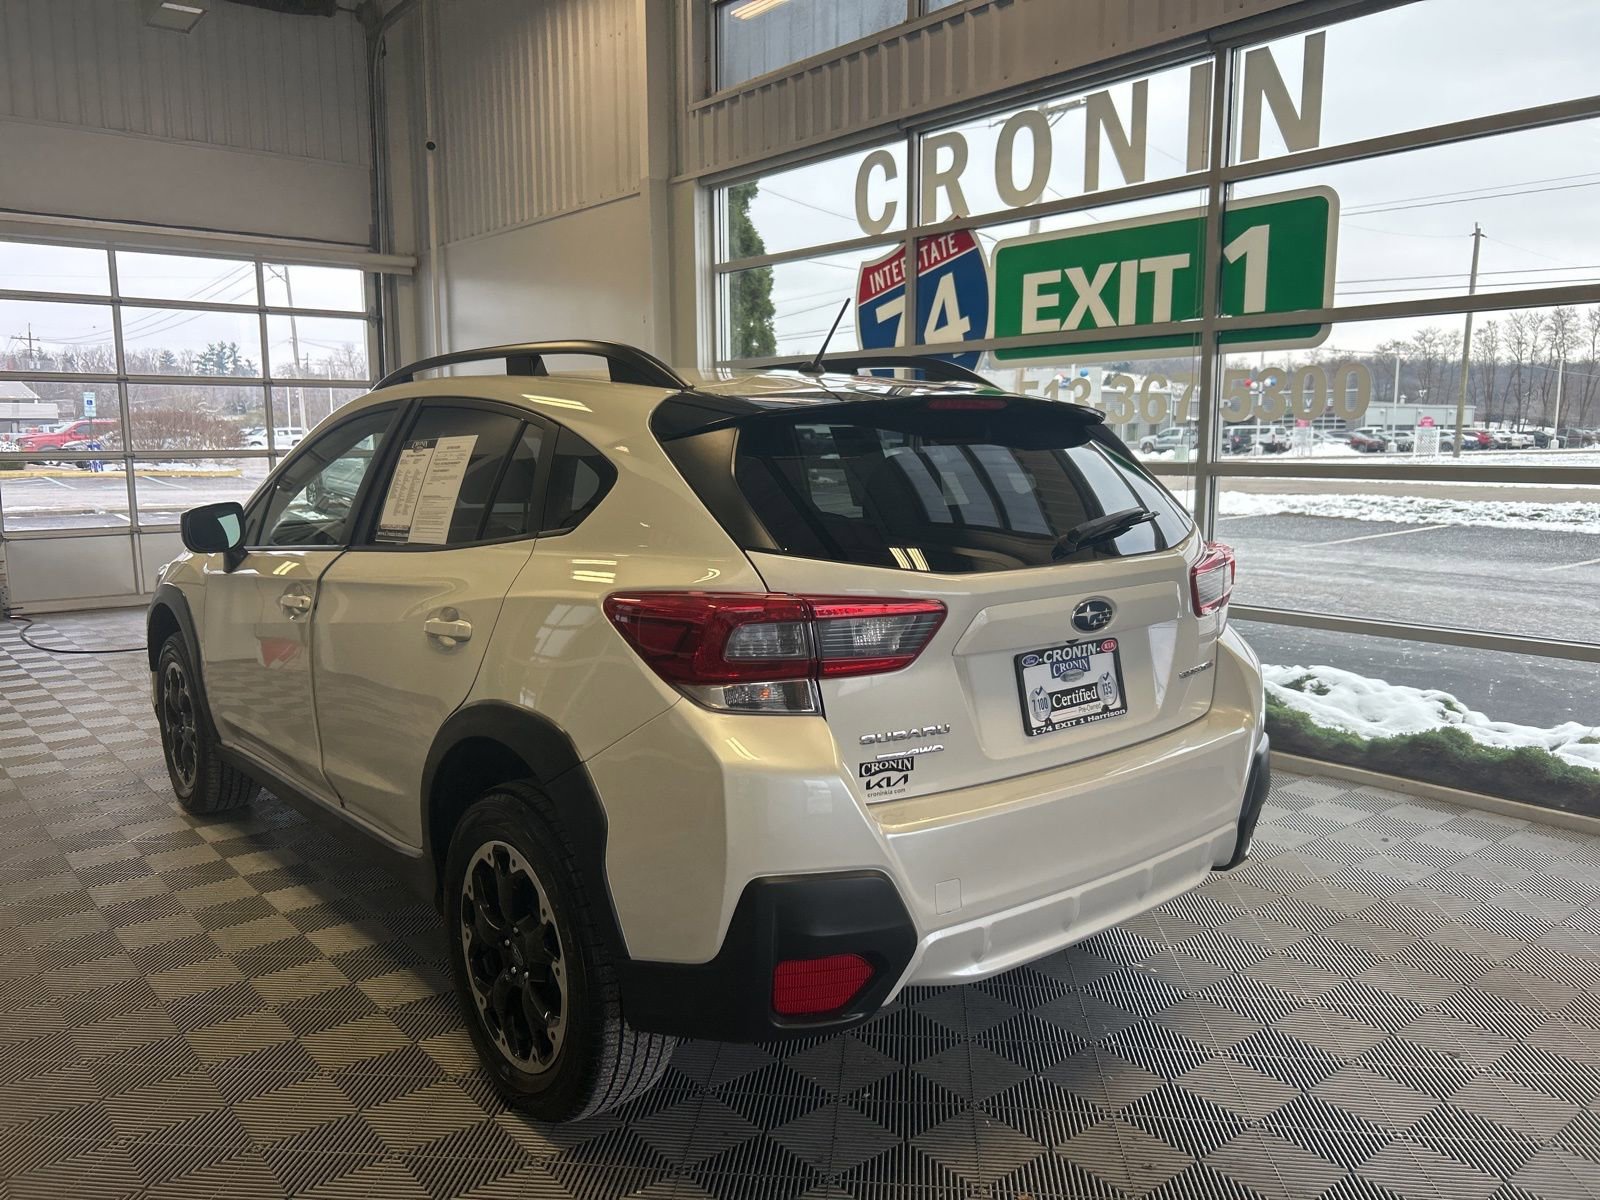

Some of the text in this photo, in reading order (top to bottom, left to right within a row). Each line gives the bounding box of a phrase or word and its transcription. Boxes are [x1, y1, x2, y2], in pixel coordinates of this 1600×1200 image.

[854, 30, 1327, 236] CRONIN
[870, 232, 959, 294] INTETATE
[1021, 224, 1271, 335] EXIT 1
[1043, 642, 1097, 664] CRONIN
[1052, 658, 1089, 676] CRONIN
[1052, 686, 1098, 708] Certified
[1031, 725, 1053, 736] I-74
[1055, 719, 1077, 730] EXIT
[1087, 708, 1126, 722] Harrison
[859, 723, 950, 745] SUBARU
[861, 757, 912, 777] CRONIN
[865, 773, 909, 790] KIA
[867, 788, 906, 798] croninkiacom
